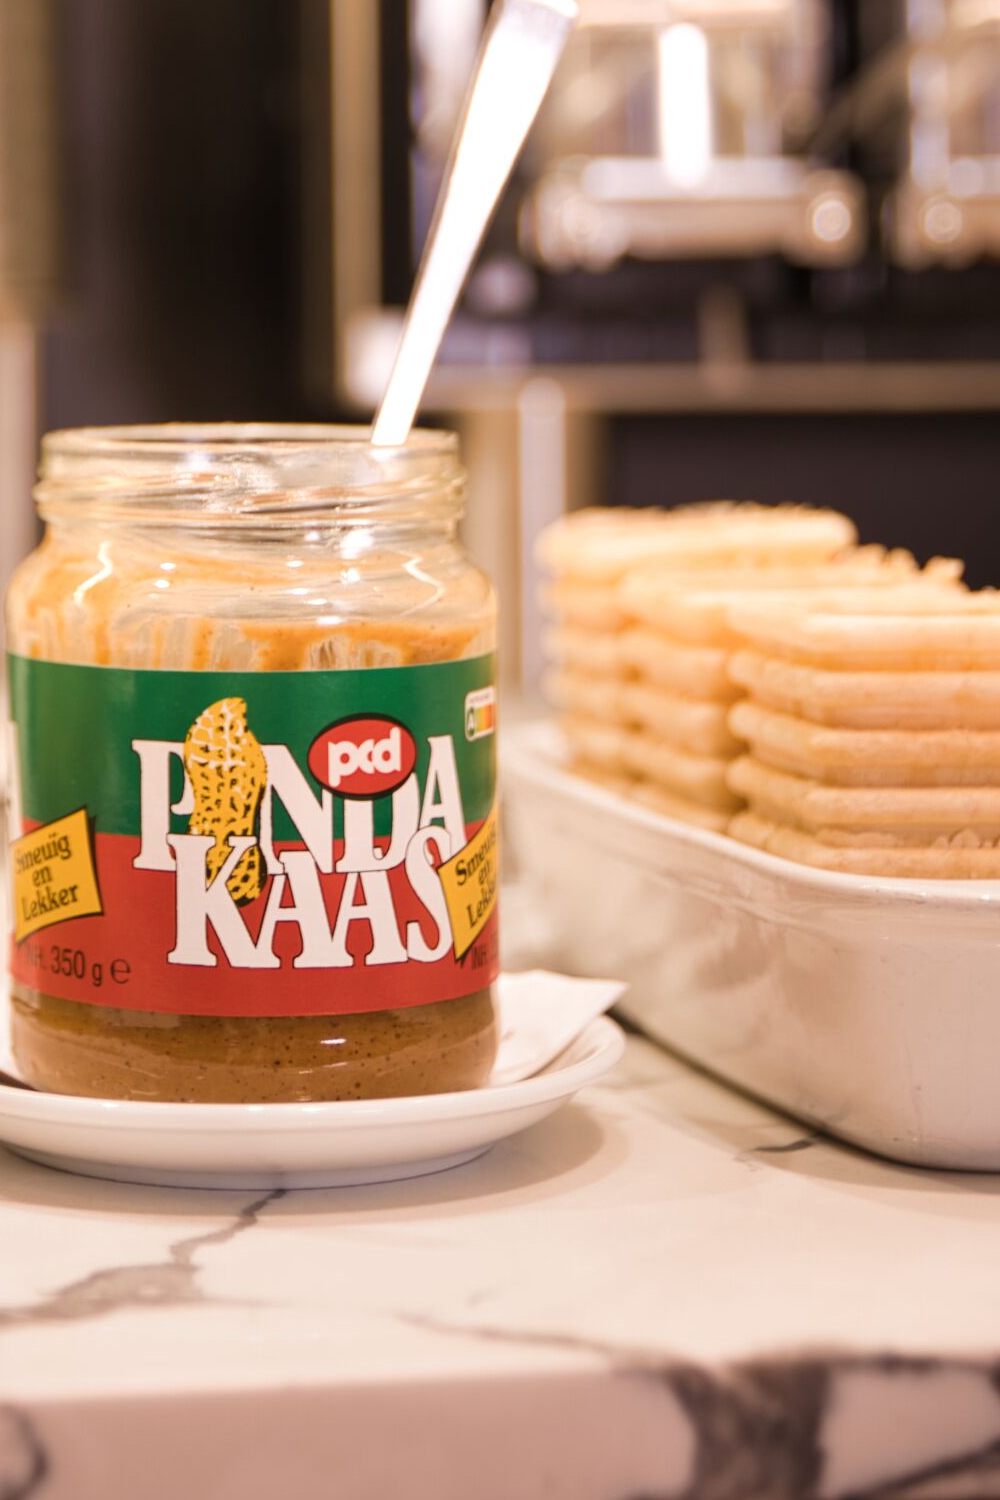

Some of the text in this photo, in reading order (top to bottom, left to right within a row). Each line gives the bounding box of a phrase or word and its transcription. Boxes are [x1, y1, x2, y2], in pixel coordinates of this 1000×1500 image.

[328, 727, 401, 788] pcd
[132, 734, 467, 876] PNDA
[32, 865, 53, 887] en
[166, 825, 454, 969] KAAS
[21, 884, 78, 921] Lekker
[50, 945, 86, 979] 350
[91, 963, 103, 987] g
